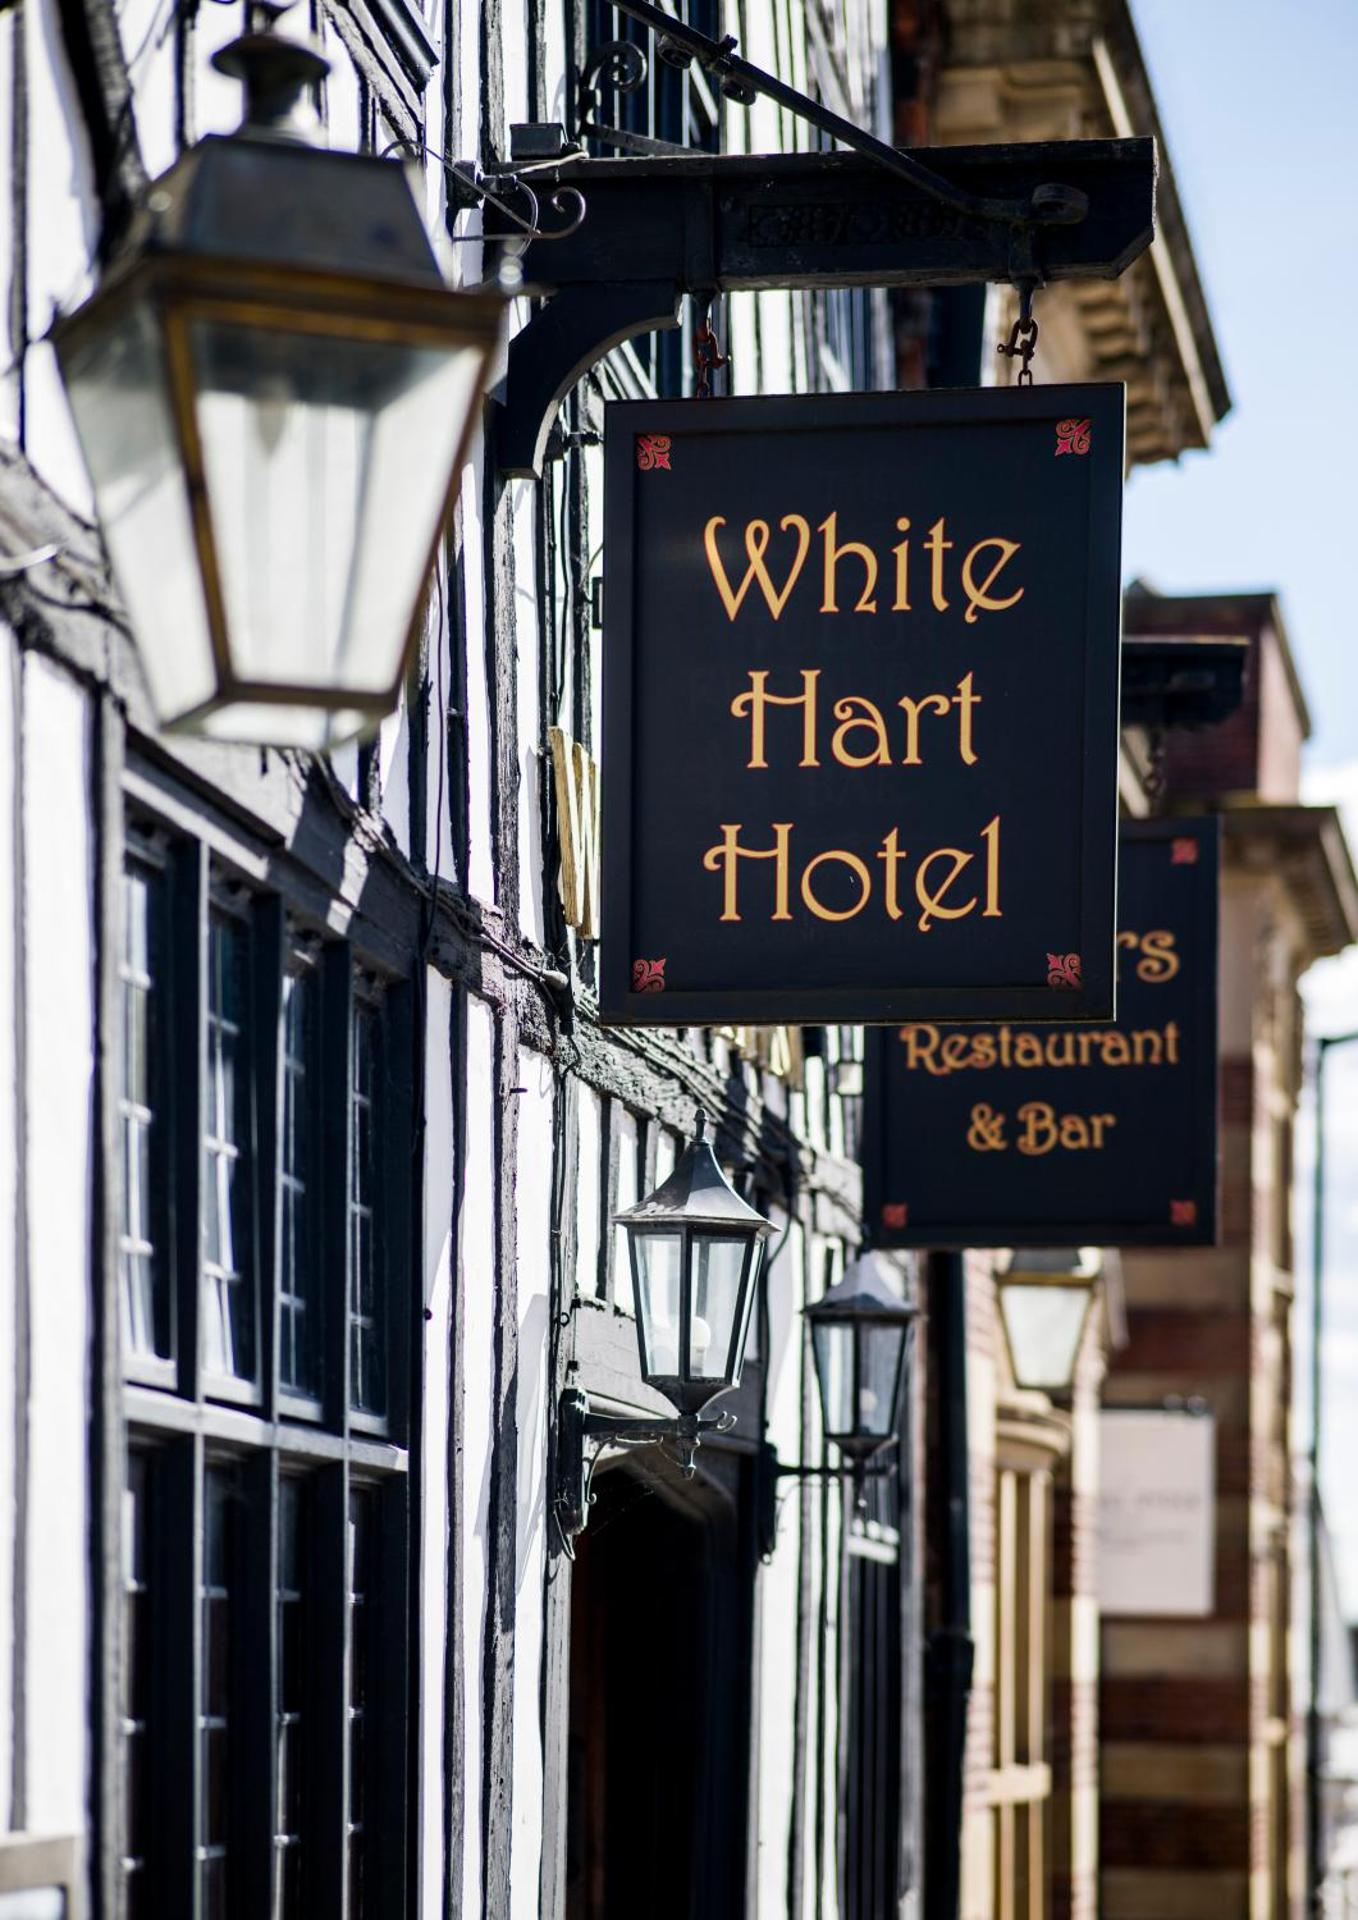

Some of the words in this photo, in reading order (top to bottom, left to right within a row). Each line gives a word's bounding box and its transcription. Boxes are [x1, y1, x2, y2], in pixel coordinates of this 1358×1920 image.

[703, 511, 1025, 624] White
[730, 669, 982, 769] Hart
[703, 816, 1003, 932] Hotel
[900, 1022, 1179, 1076] Restaurant
[967, 1103, 1007, 1151] &
[1017, 1101, 1117, 1156] Bar
